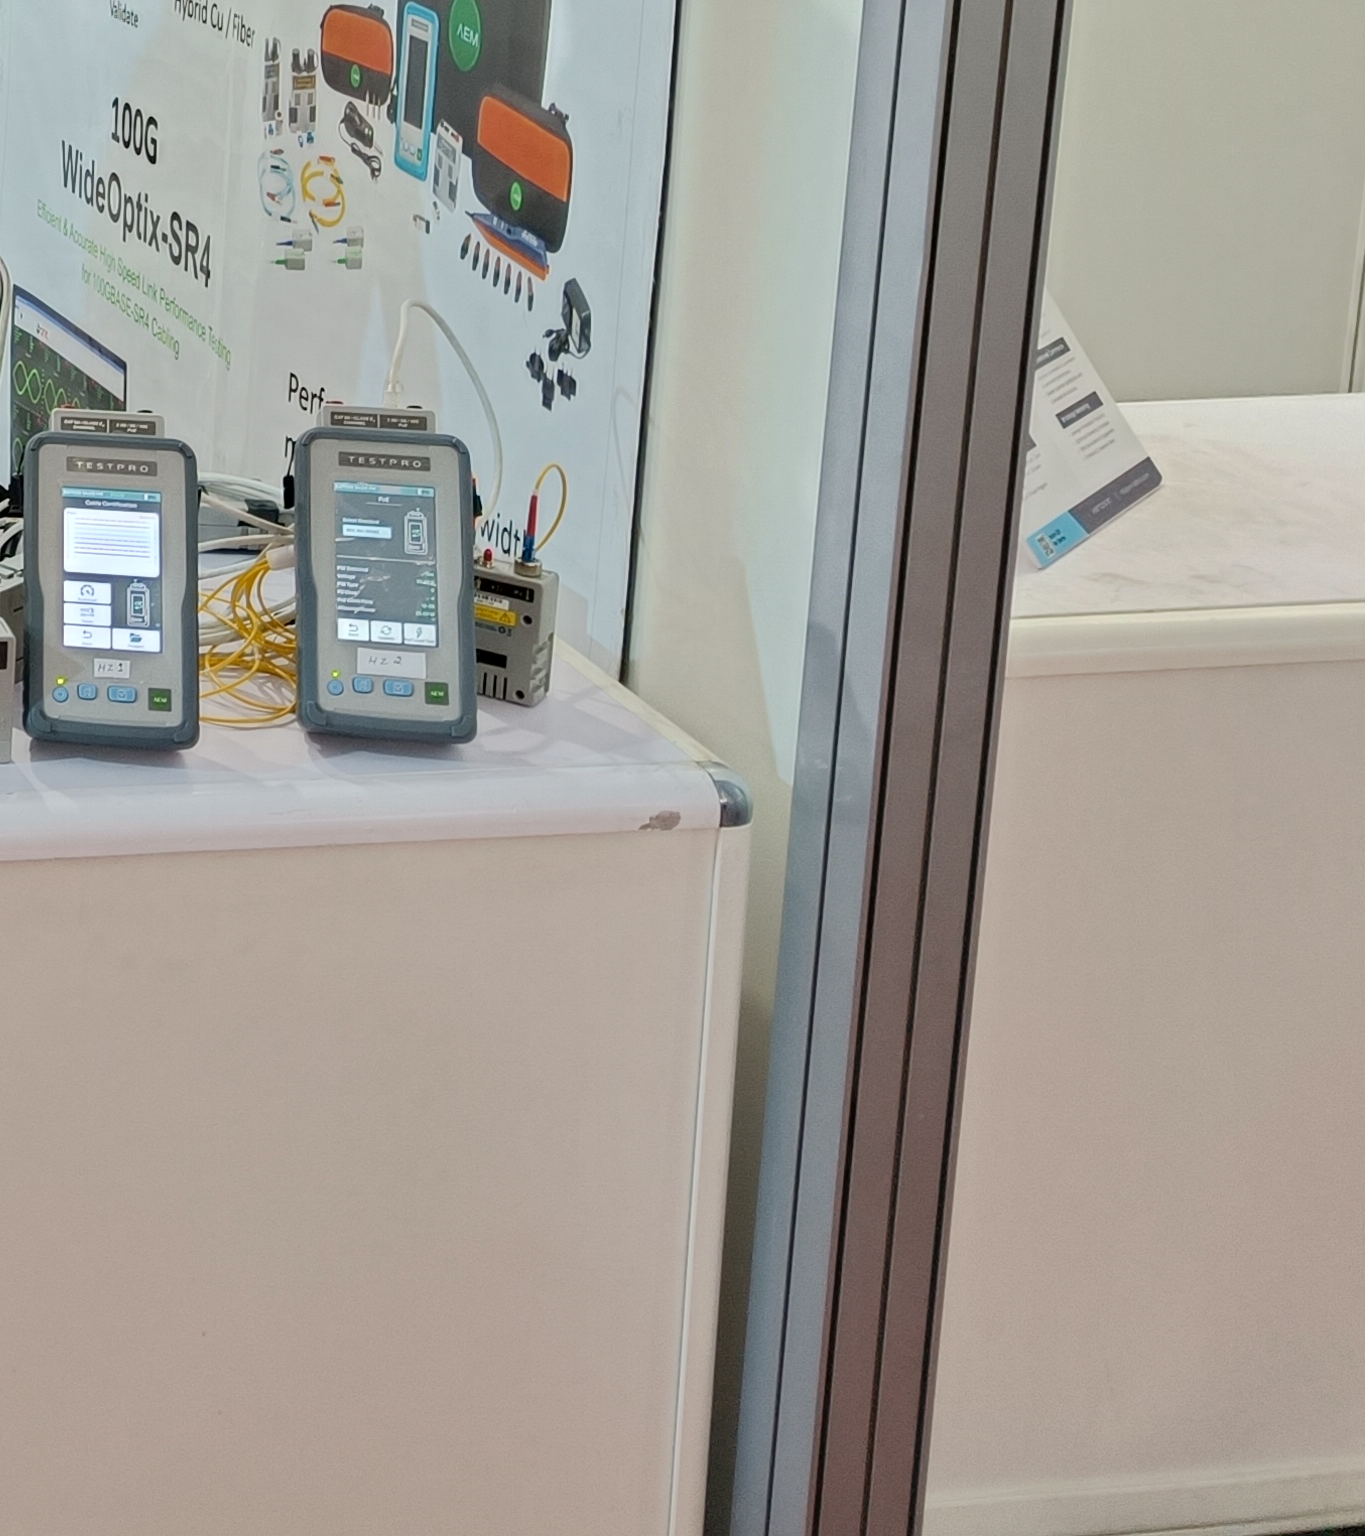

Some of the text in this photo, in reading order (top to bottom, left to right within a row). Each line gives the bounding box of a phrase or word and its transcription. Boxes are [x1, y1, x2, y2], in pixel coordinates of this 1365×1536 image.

[210, 3, 224, 31] Cu
[232, 13, 256, 48] Fiber
[111, 97, 159, 164] 100G
[61, 140, 212, 288] WideOptix-SR4
[75, 460, 149, 473] TESTPRO
[348, 455, 422, 468] TESTPRO
